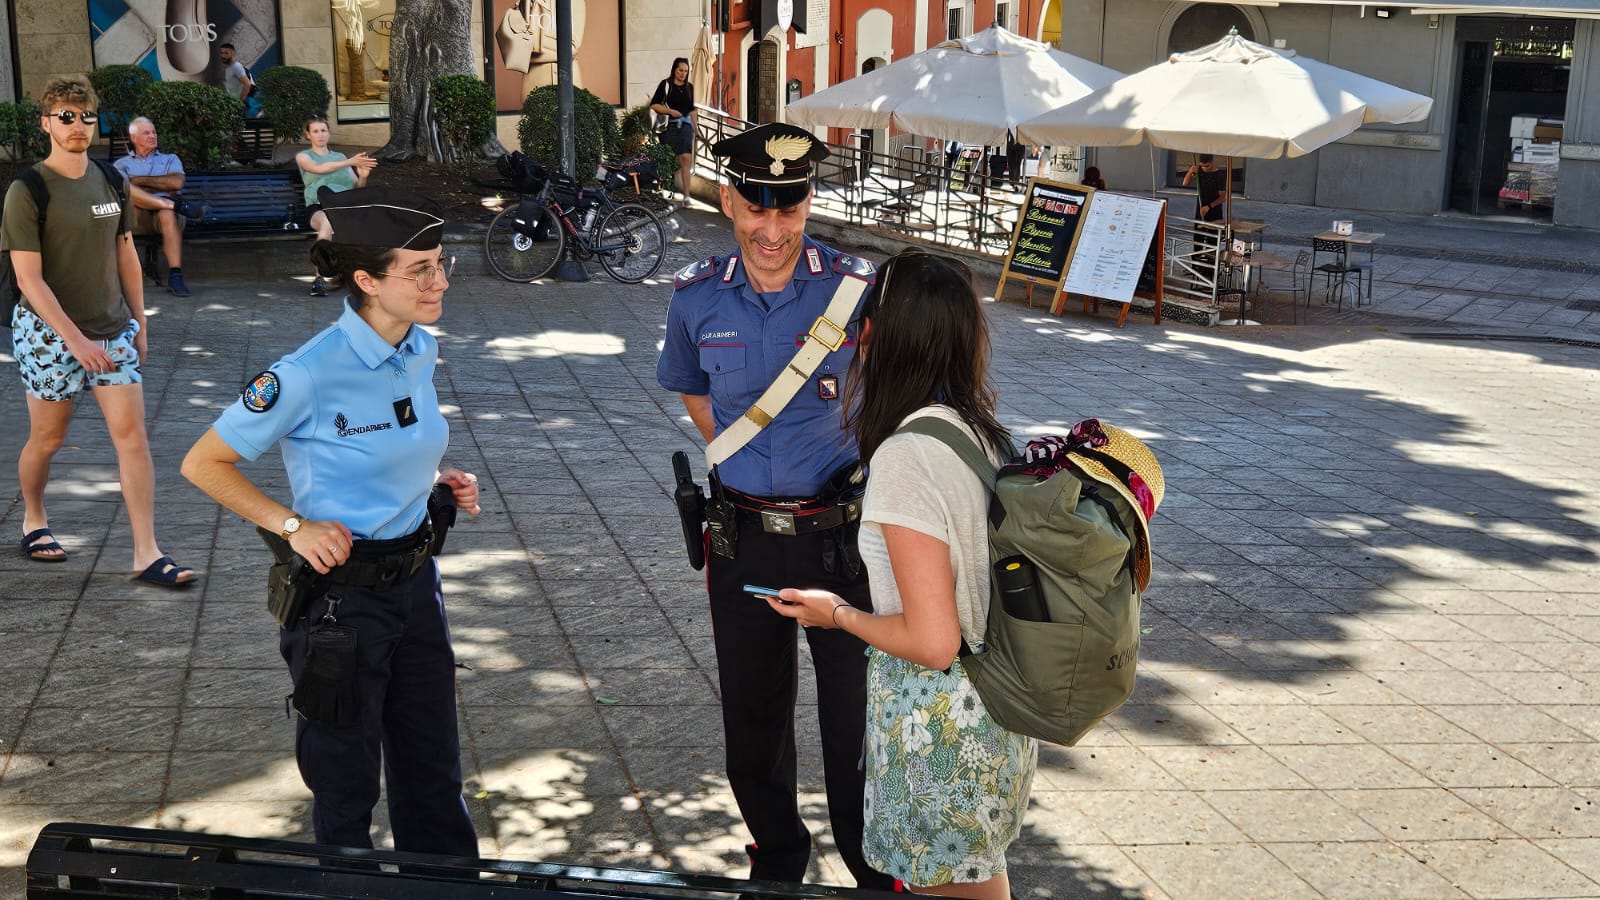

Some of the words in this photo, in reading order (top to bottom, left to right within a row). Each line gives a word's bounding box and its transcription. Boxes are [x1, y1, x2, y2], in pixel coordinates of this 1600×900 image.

[156, 23, 218, 42] TOD'S
[701, 331, 738, 341] CARABINIERI
[337, 422, 393, 437] GENDARMERIE
